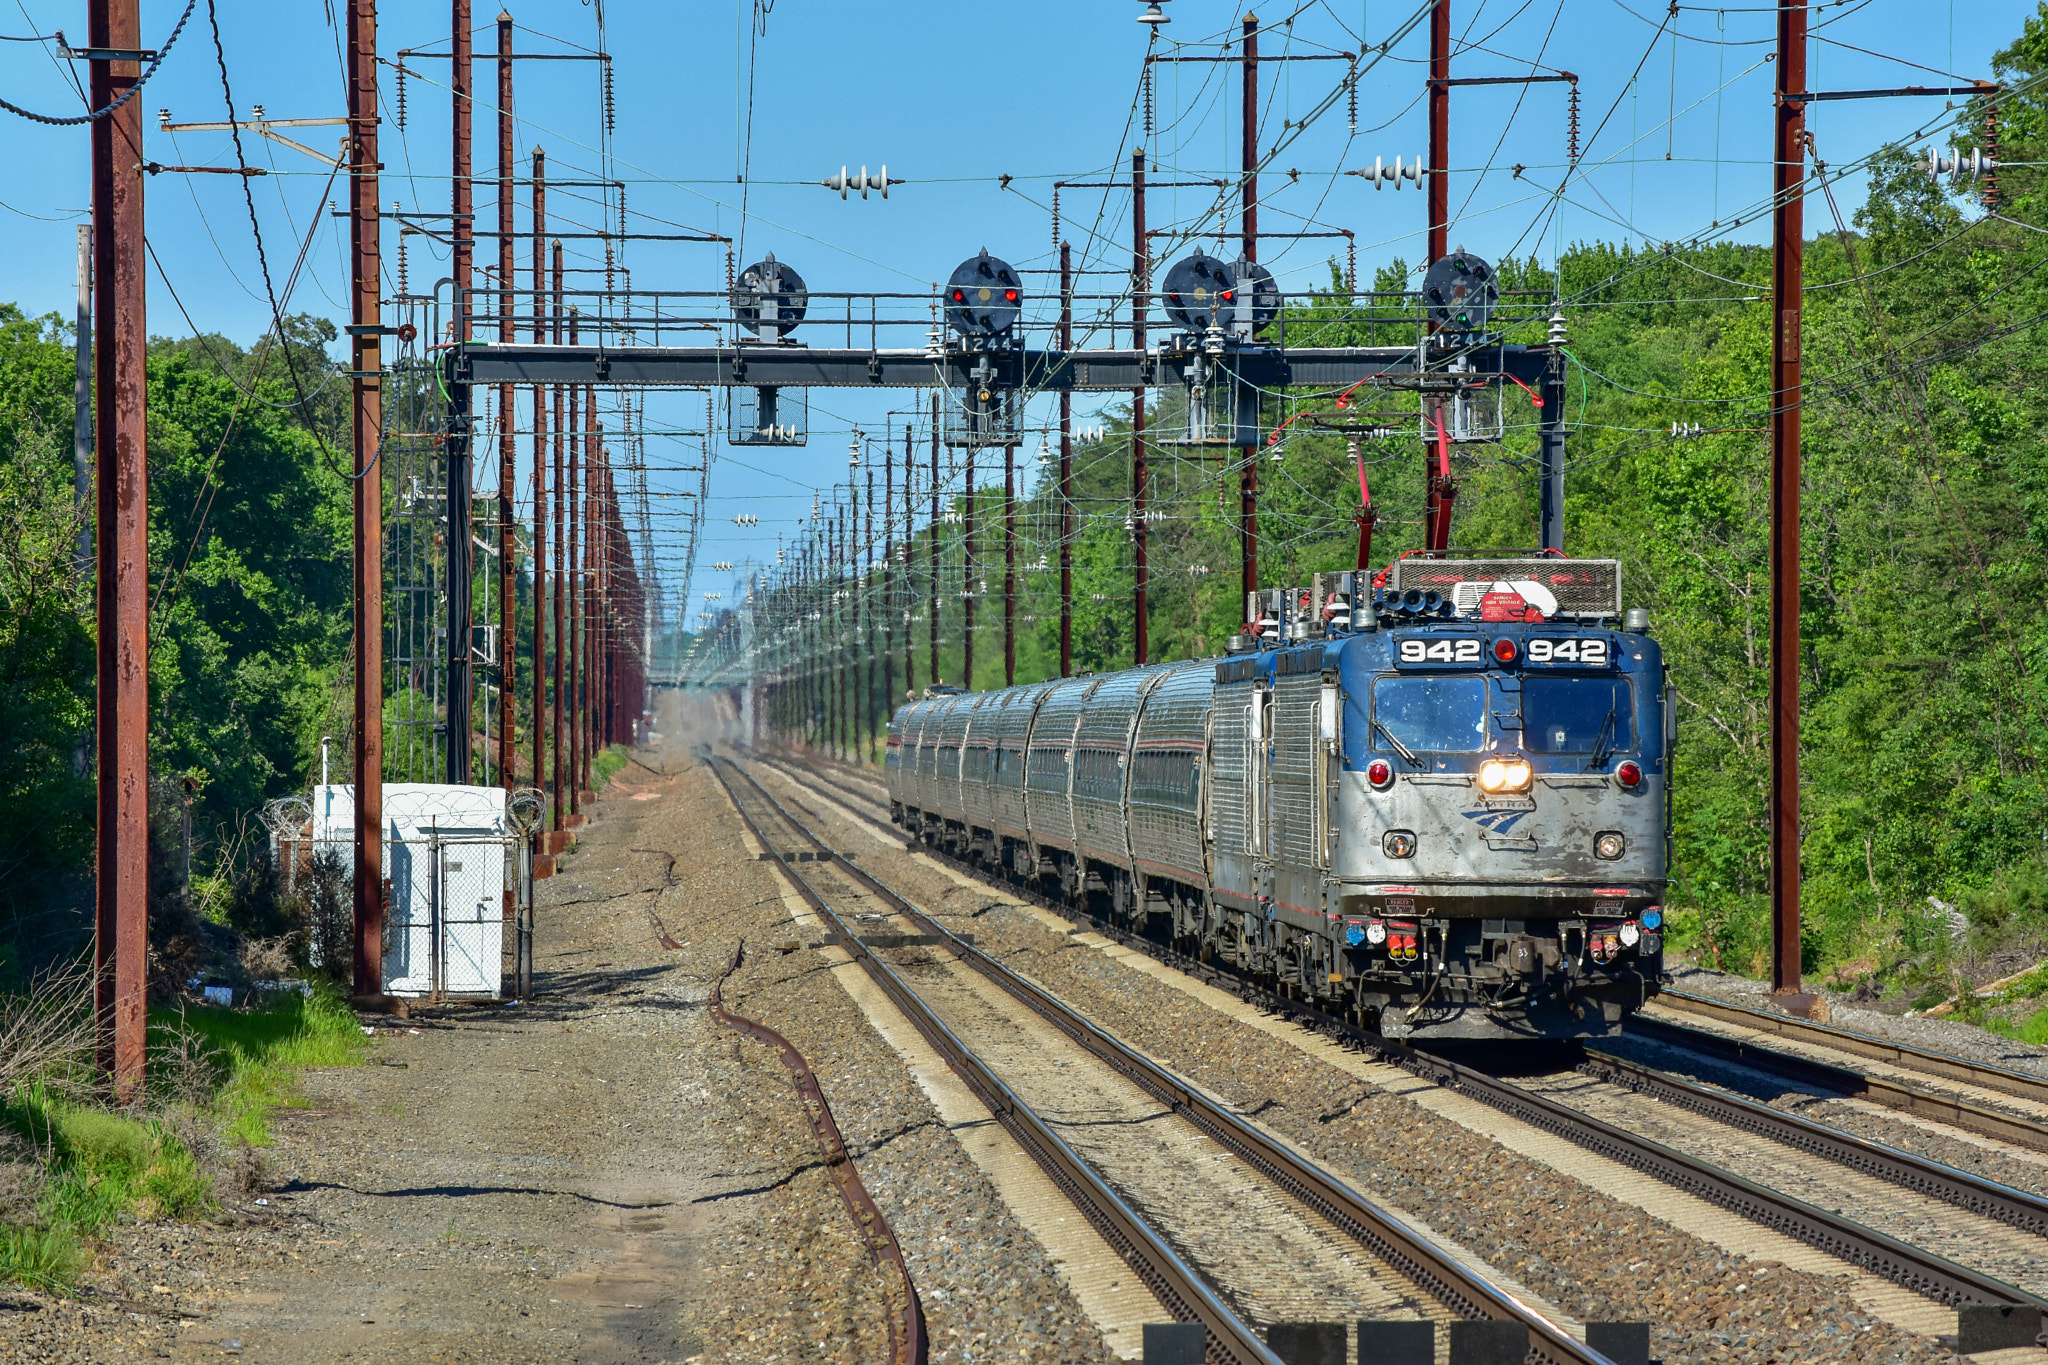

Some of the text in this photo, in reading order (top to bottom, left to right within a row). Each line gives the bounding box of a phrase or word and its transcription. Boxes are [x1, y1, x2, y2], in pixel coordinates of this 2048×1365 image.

[962, 336, 1012, 352] 1244
[1439, 333, 1488, 348] 1244
[1400, 640, 1481, 663] 942
[1528, 640, 1606, 663] 942
